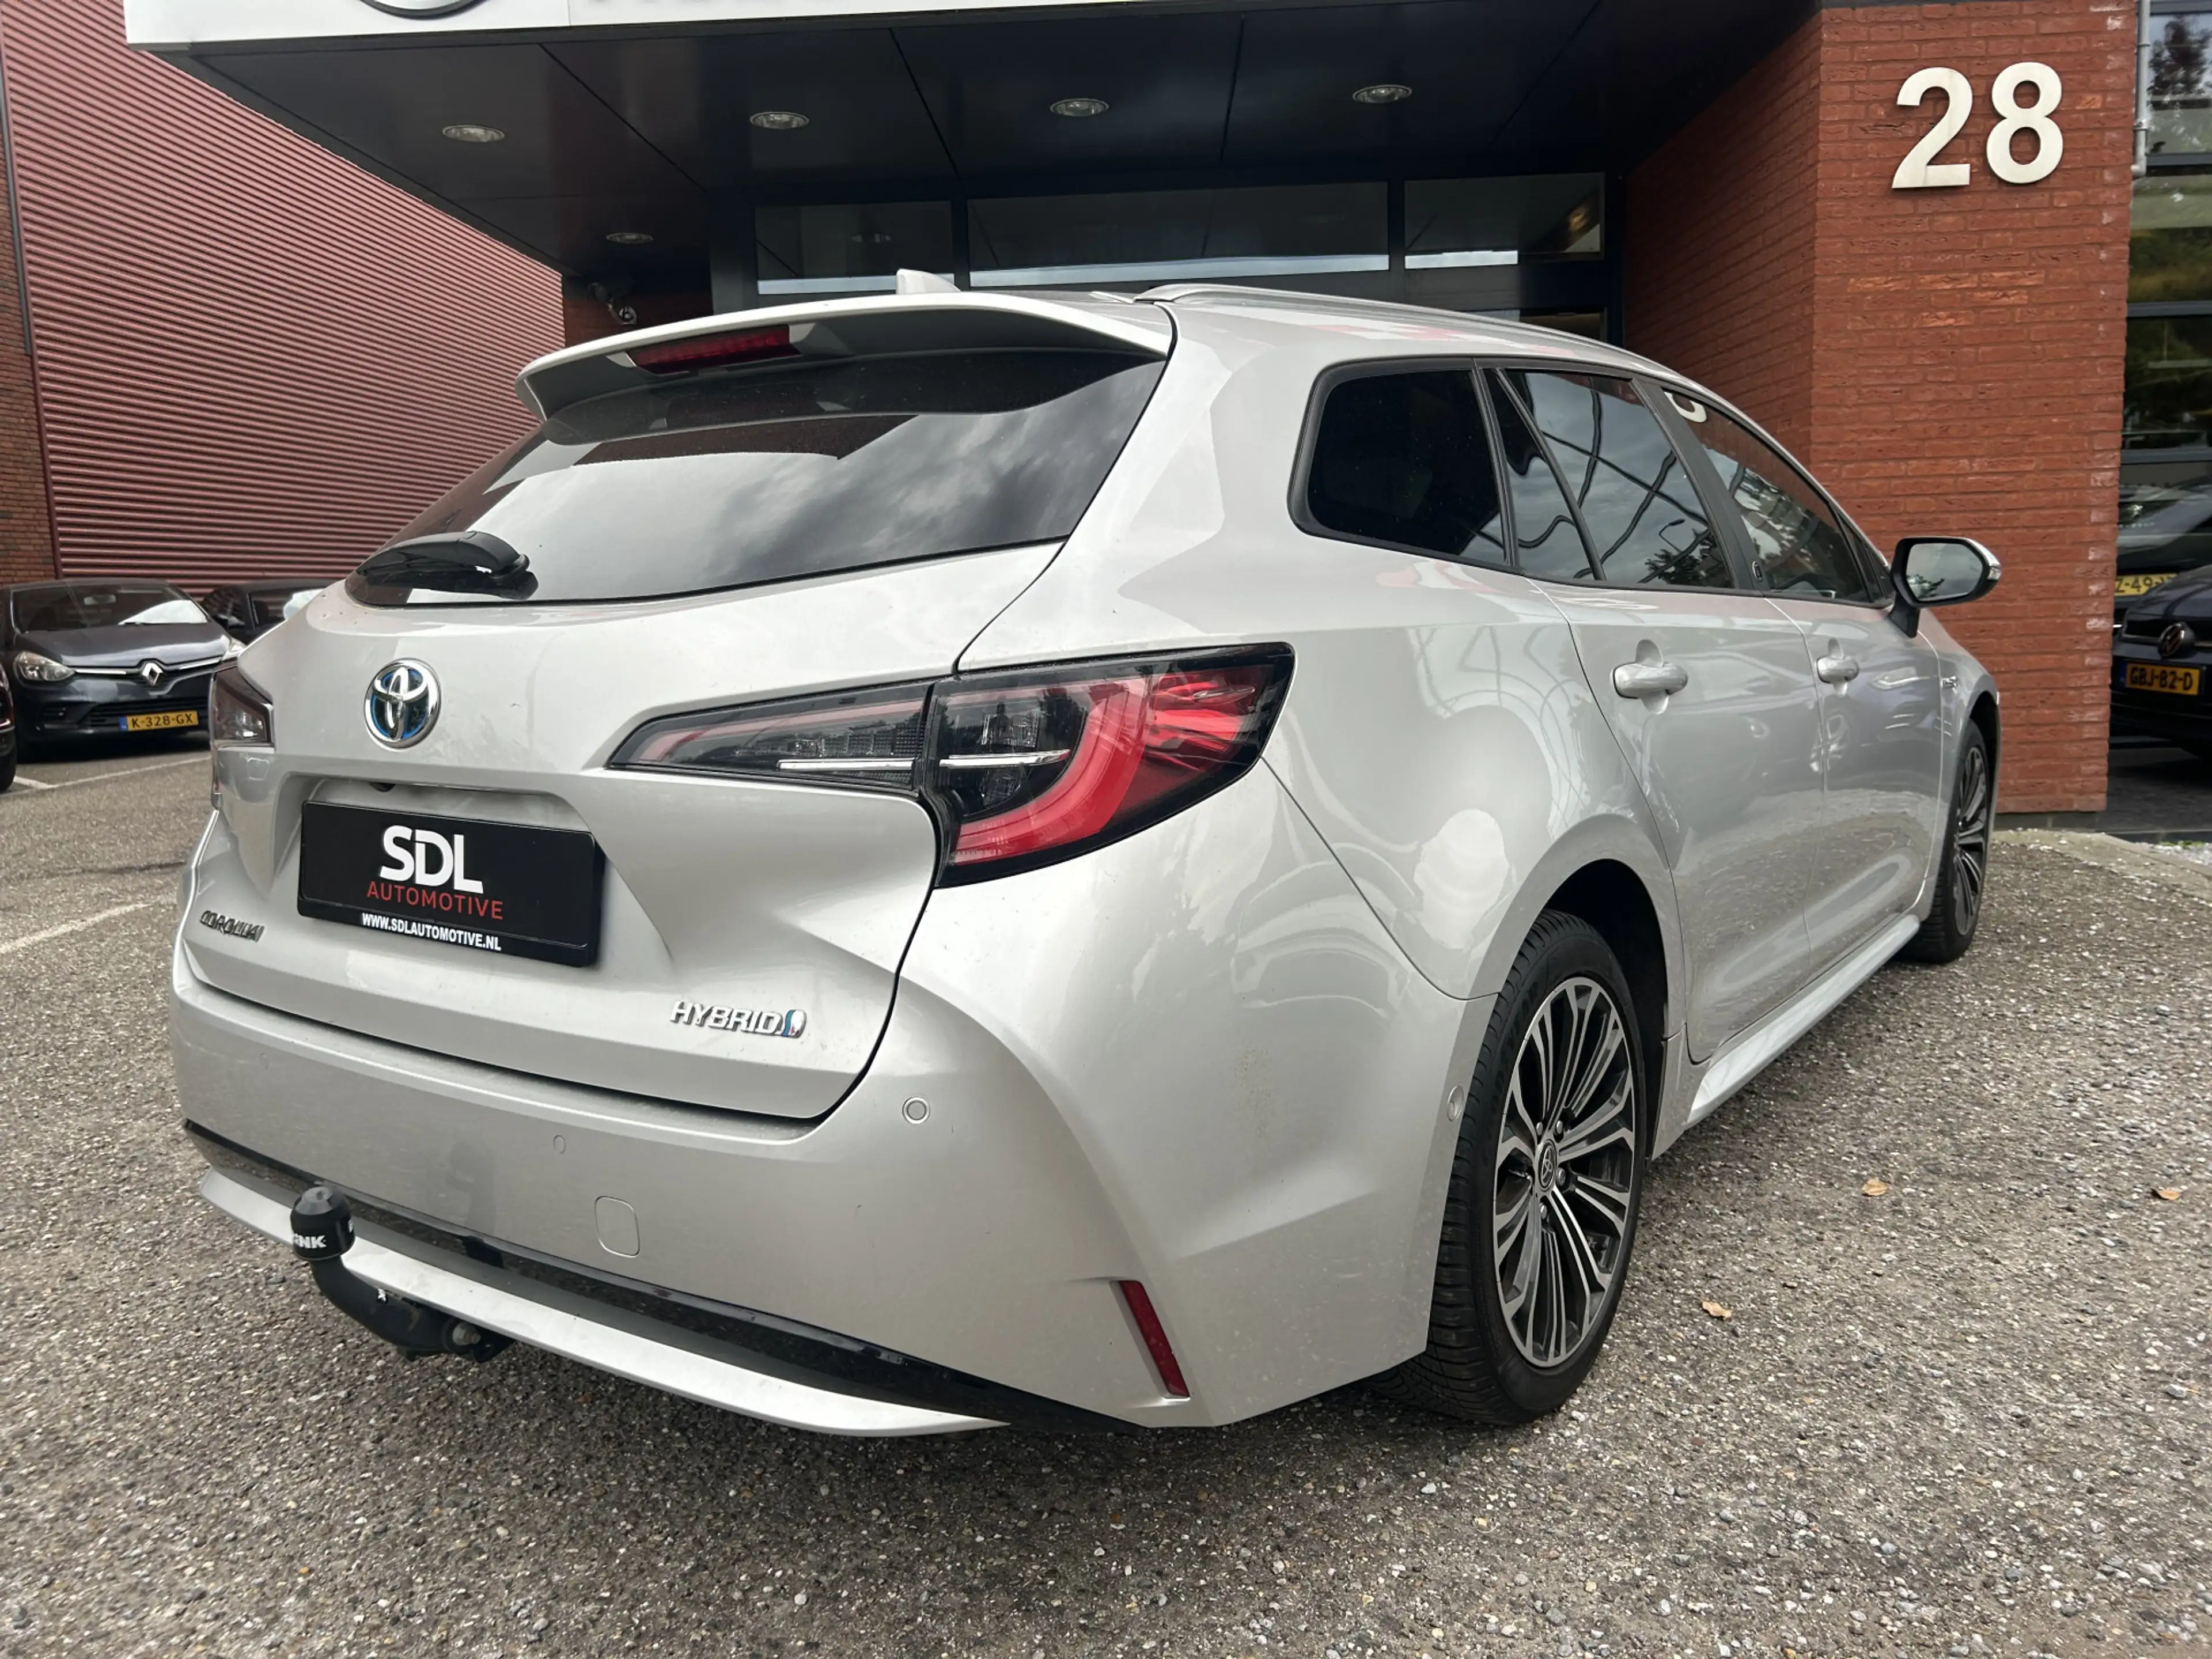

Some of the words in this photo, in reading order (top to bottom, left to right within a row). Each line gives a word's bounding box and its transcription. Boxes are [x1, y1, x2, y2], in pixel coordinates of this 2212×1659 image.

[1892, 62, 2063, 189] 28
[132, 713, 194, 729] K-328-GX
[380, 825, 483, 893] SDL
[366, 880, 503, 920] AUTOMOTIVE
[200, 910, 265, 942] COROLLA
[362, 912, 501, 951] WWW.SDLAUTOMOTIVE.NL
[670, 1001, 784, 1036] HYBRID
